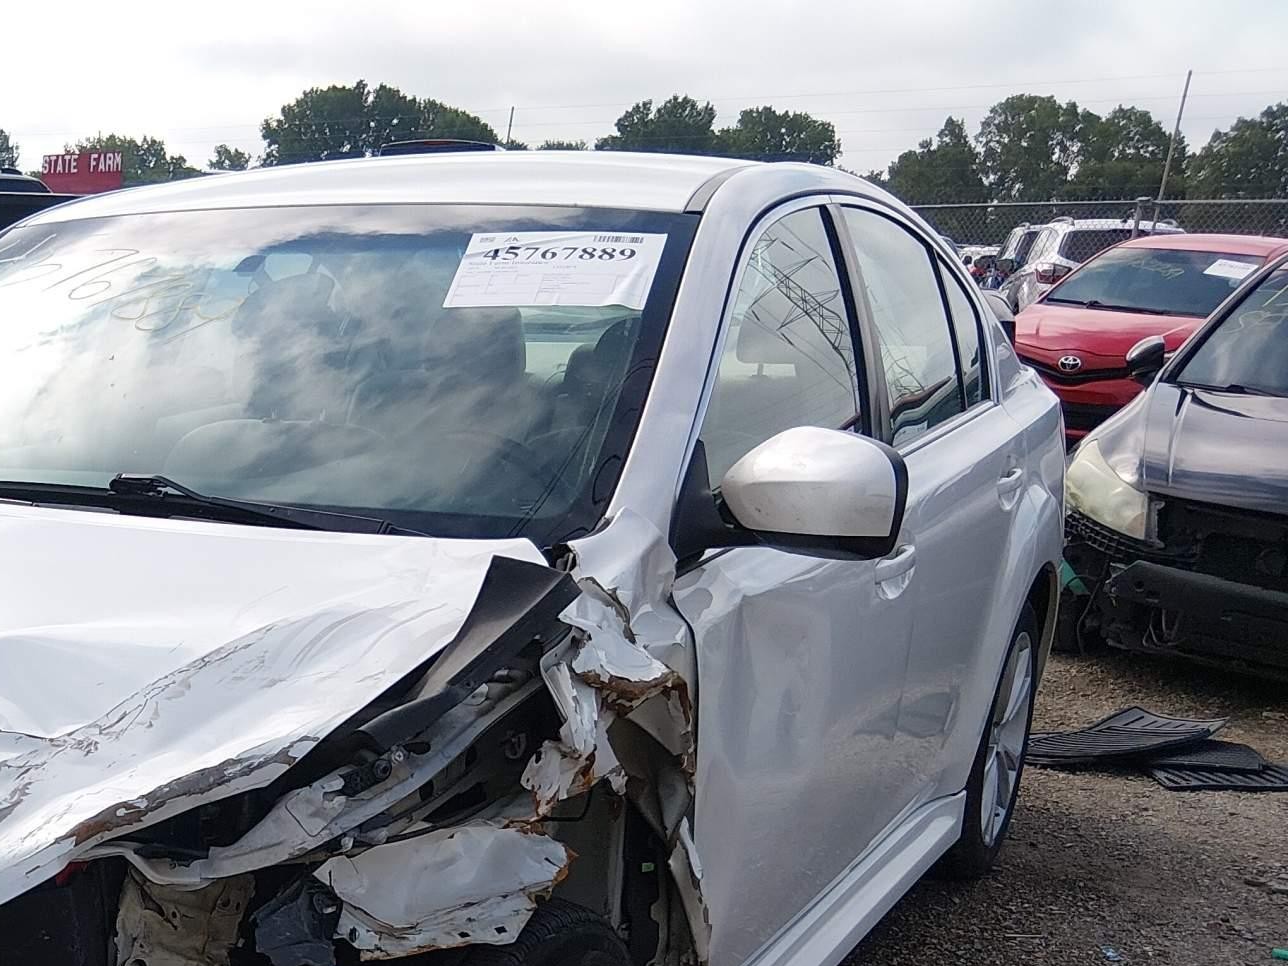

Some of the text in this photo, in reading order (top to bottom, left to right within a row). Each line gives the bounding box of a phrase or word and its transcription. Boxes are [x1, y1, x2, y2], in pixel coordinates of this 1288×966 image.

[42, 152, 122, 174] STATE FARM
[482, 245, 638, 262] 45767889
